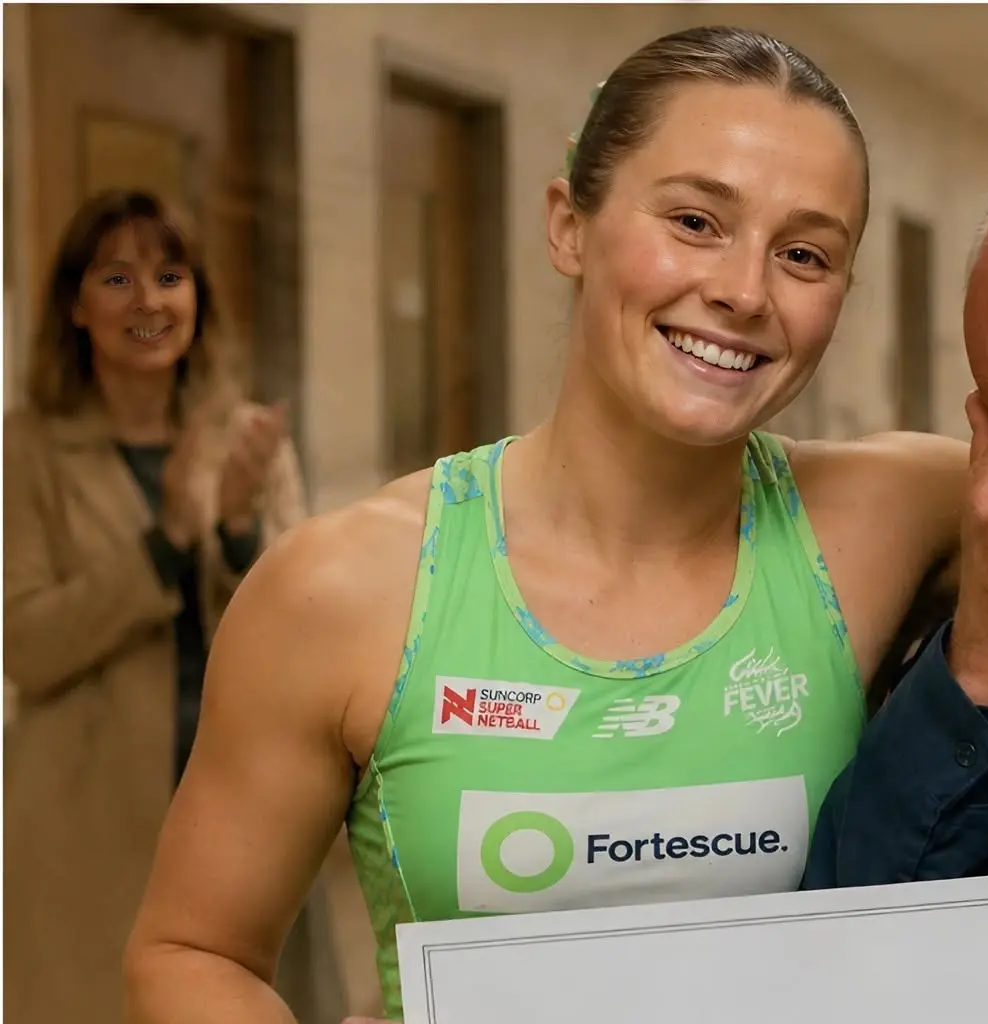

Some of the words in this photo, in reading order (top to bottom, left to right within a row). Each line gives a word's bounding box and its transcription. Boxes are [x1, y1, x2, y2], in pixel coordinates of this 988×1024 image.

[480, 688, 542, 704] SUNCORP
[724, 673, 809, 717] FEVER
[478, 702, 523, 716] SUPER
[477, 714, 541, 731] NETBALL
